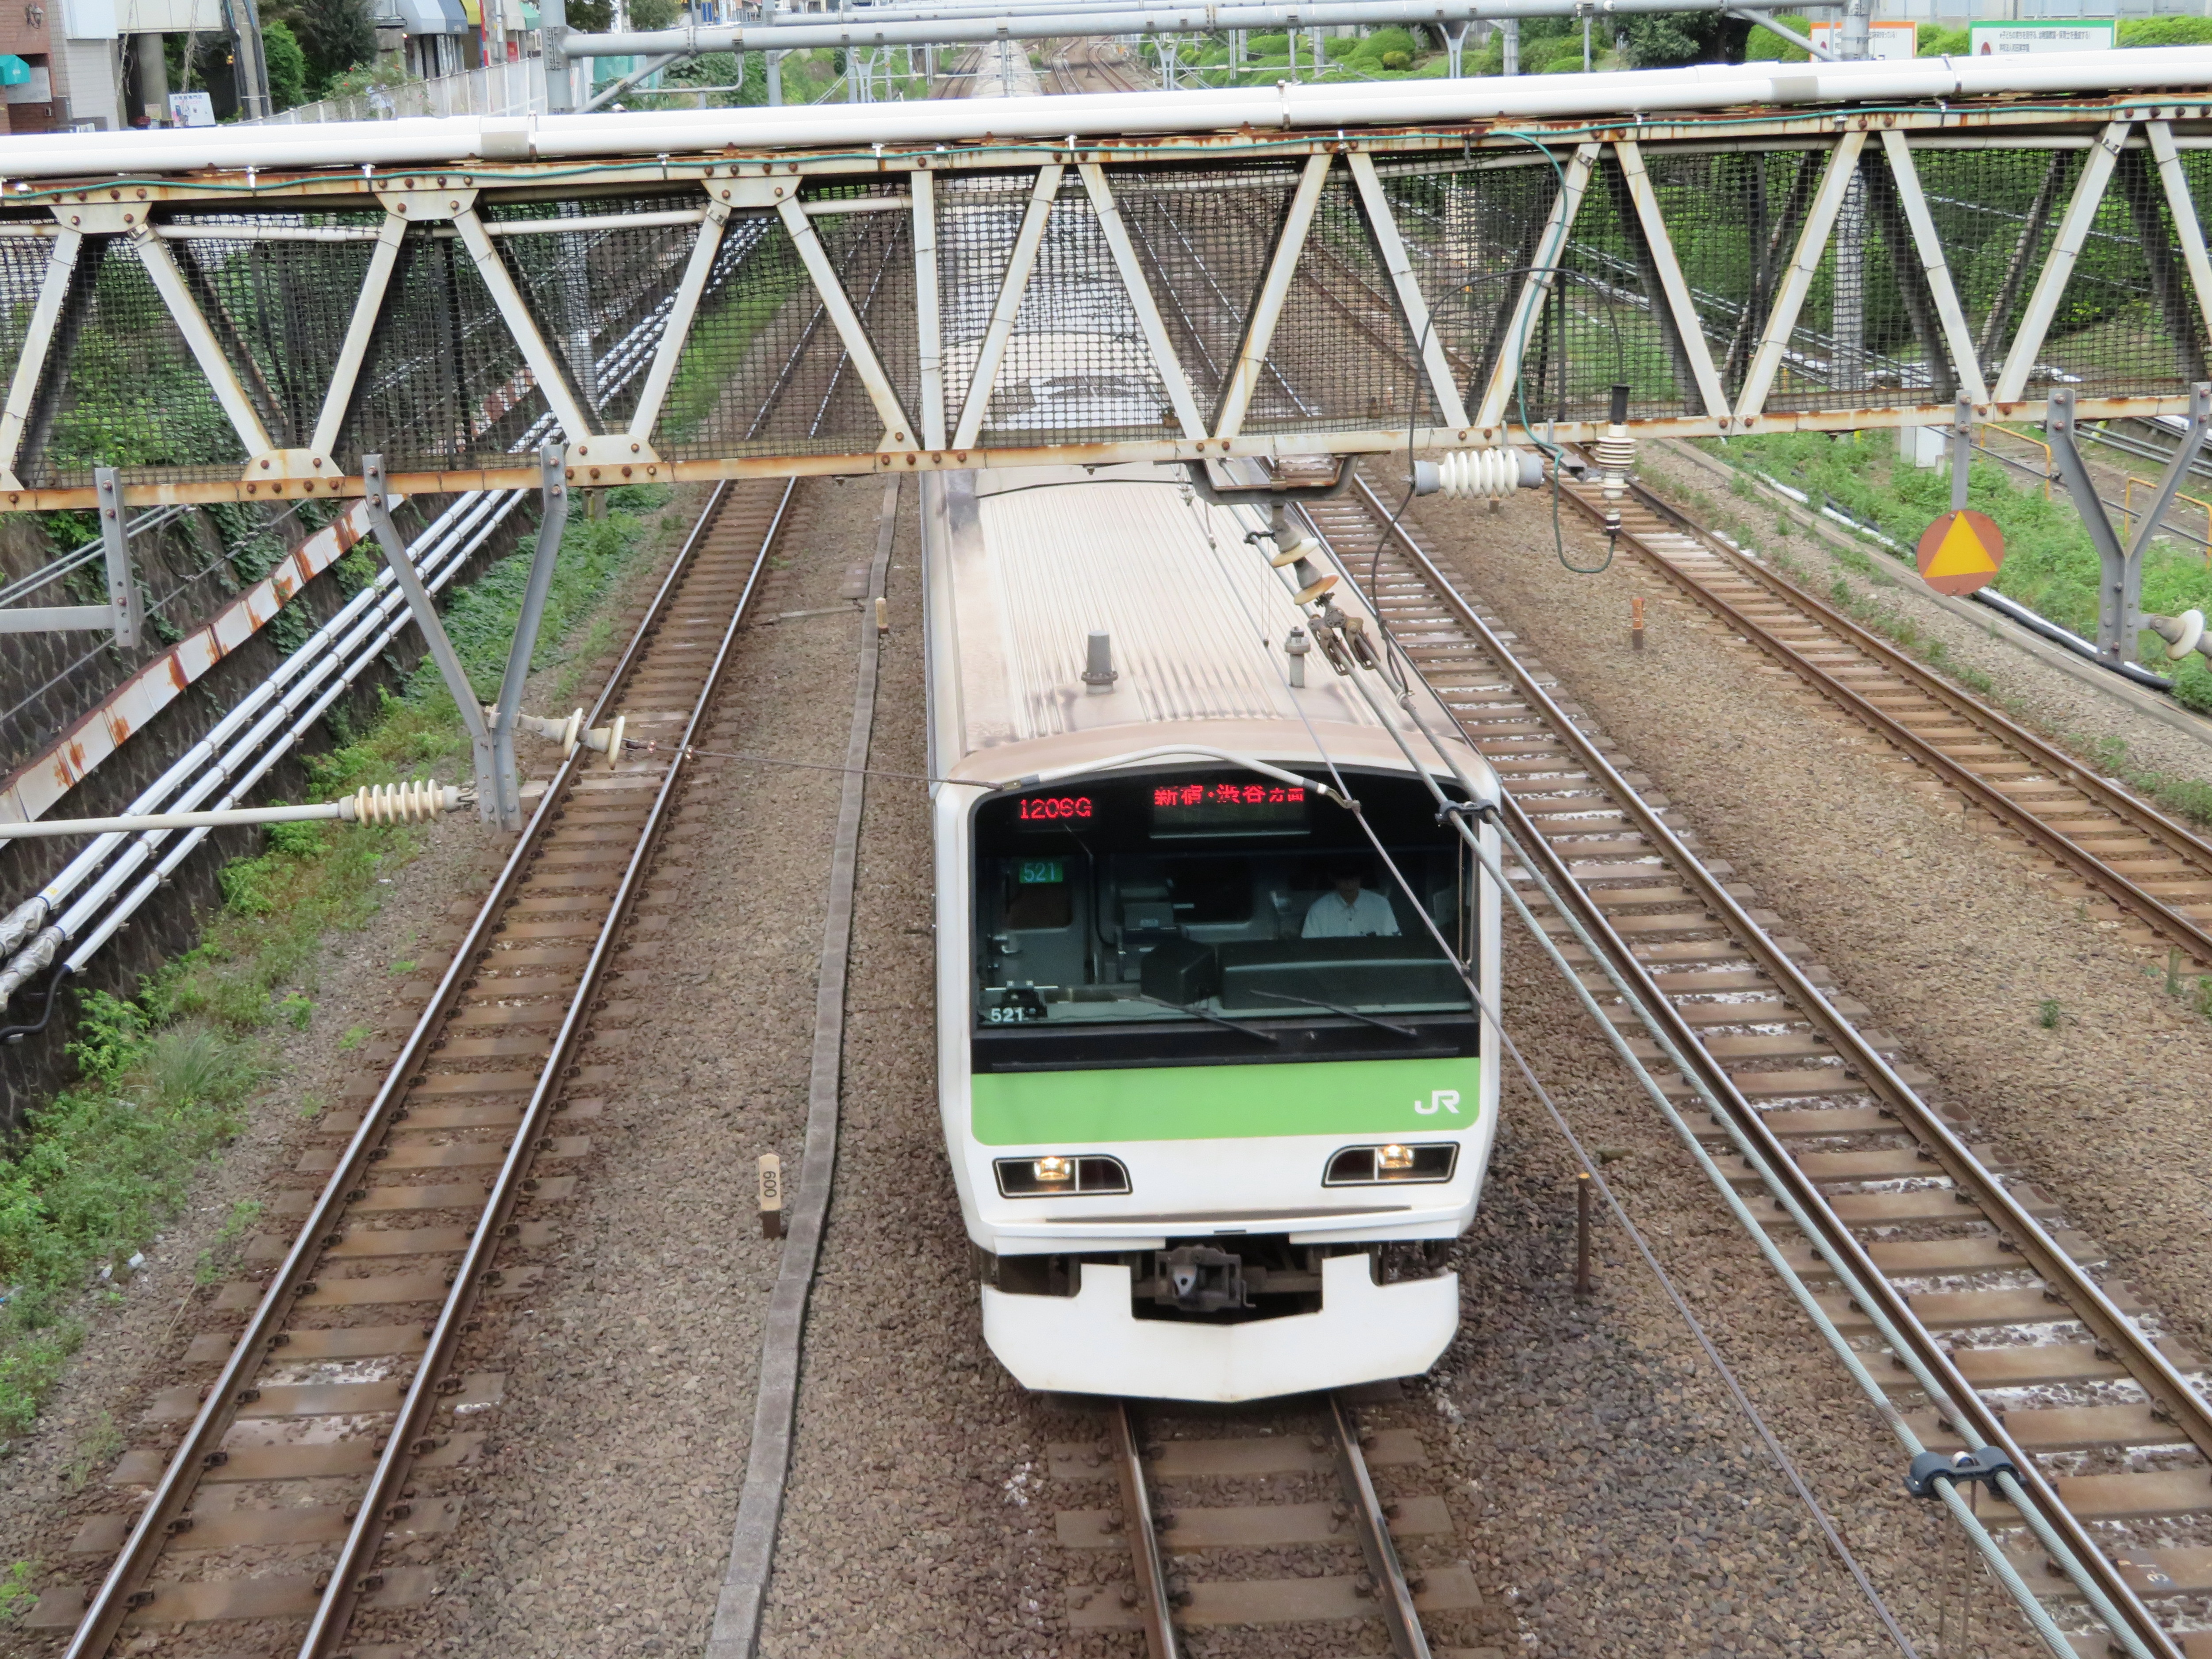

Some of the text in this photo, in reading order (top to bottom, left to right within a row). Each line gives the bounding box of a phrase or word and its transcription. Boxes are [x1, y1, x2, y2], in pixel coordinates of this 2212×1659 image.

[1154, 784, 1304, 806] 新宿・渋谷方面
[1024, 862, 1055, 882] 521
[991, 1007, 1024, 1022] 521
[1414, 1090, 1460, 1115] JR
[763, 1171, 777, 1198] 600
